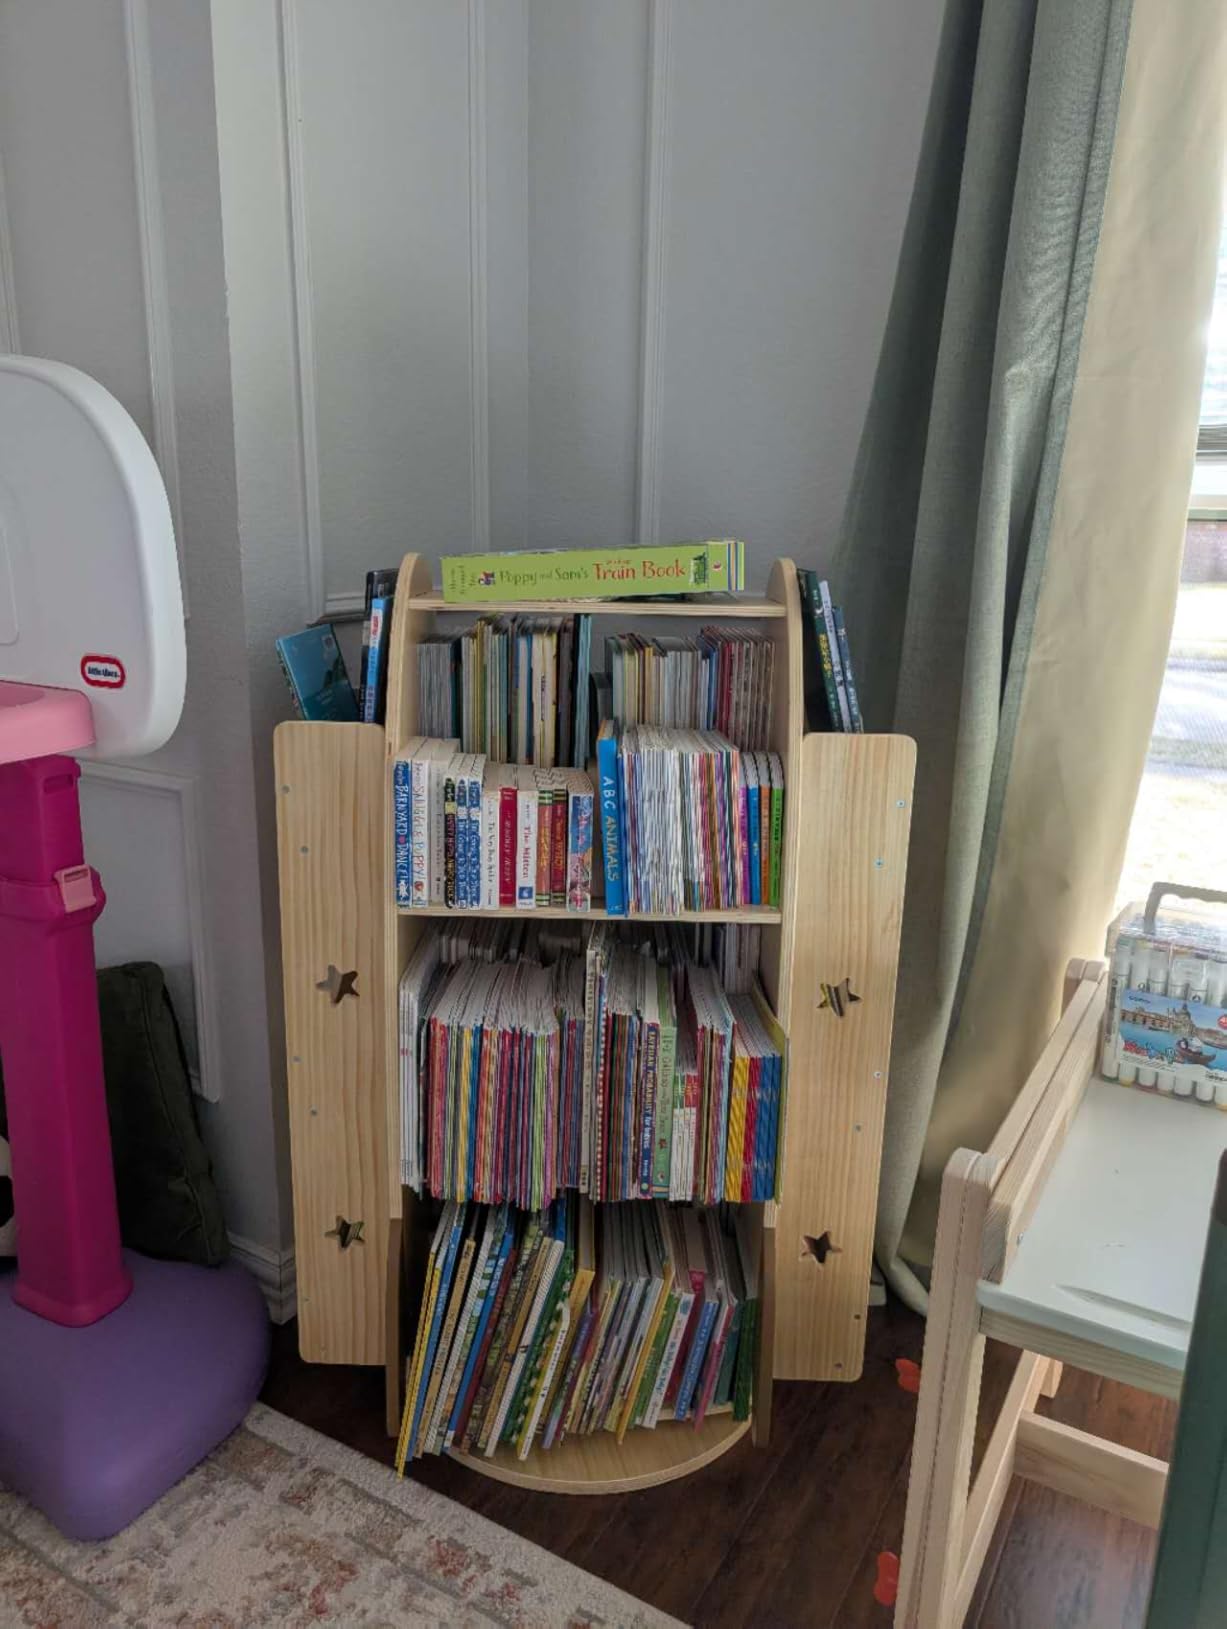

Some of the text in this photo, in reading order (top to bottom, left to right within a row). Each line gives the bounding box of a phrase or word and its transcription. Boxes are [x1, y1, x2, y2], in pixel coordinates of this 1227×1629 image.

[500, 570, 537, 586] Poppy
[555, 567, 589, 581] Sam's
[592, 560, 636, 580] Train
[642, 559, 686, 578] Book
[395, 784, 409, 835] BARNYARD
[412, 785, 426, 837] SNUGGLE
[523, 825, 531, 844] The
[602, 776, 619, 881] ABC ANIMALS
